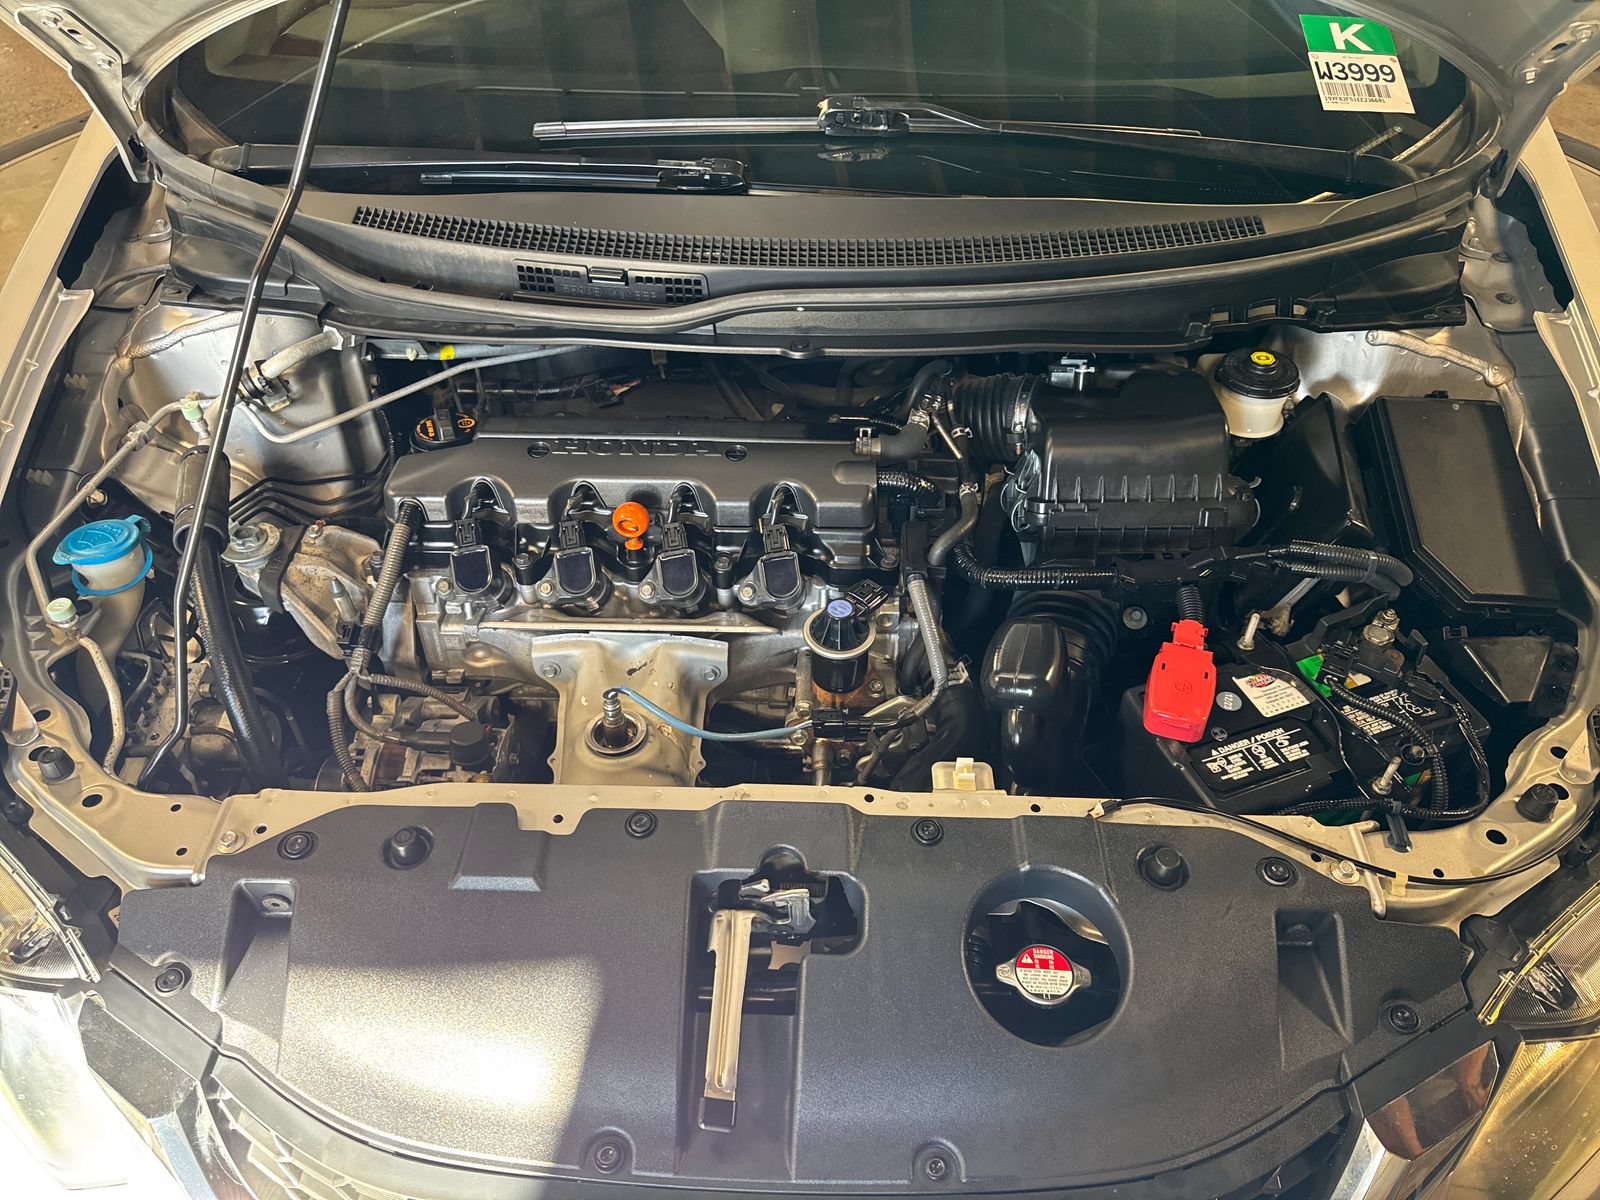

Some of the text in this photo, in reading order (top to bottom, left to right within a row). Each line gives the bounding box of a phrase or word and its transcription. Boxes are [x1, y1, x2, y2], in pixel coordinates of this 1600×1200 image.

[1329, 23, 1374, 51] K
[1314, 61, 1396, 83] W3999
[551, 439, 722, 456] HONDA
[1218, 739, 1250, 753] DANGER
[1255, 727, 1285, 741] POISON
